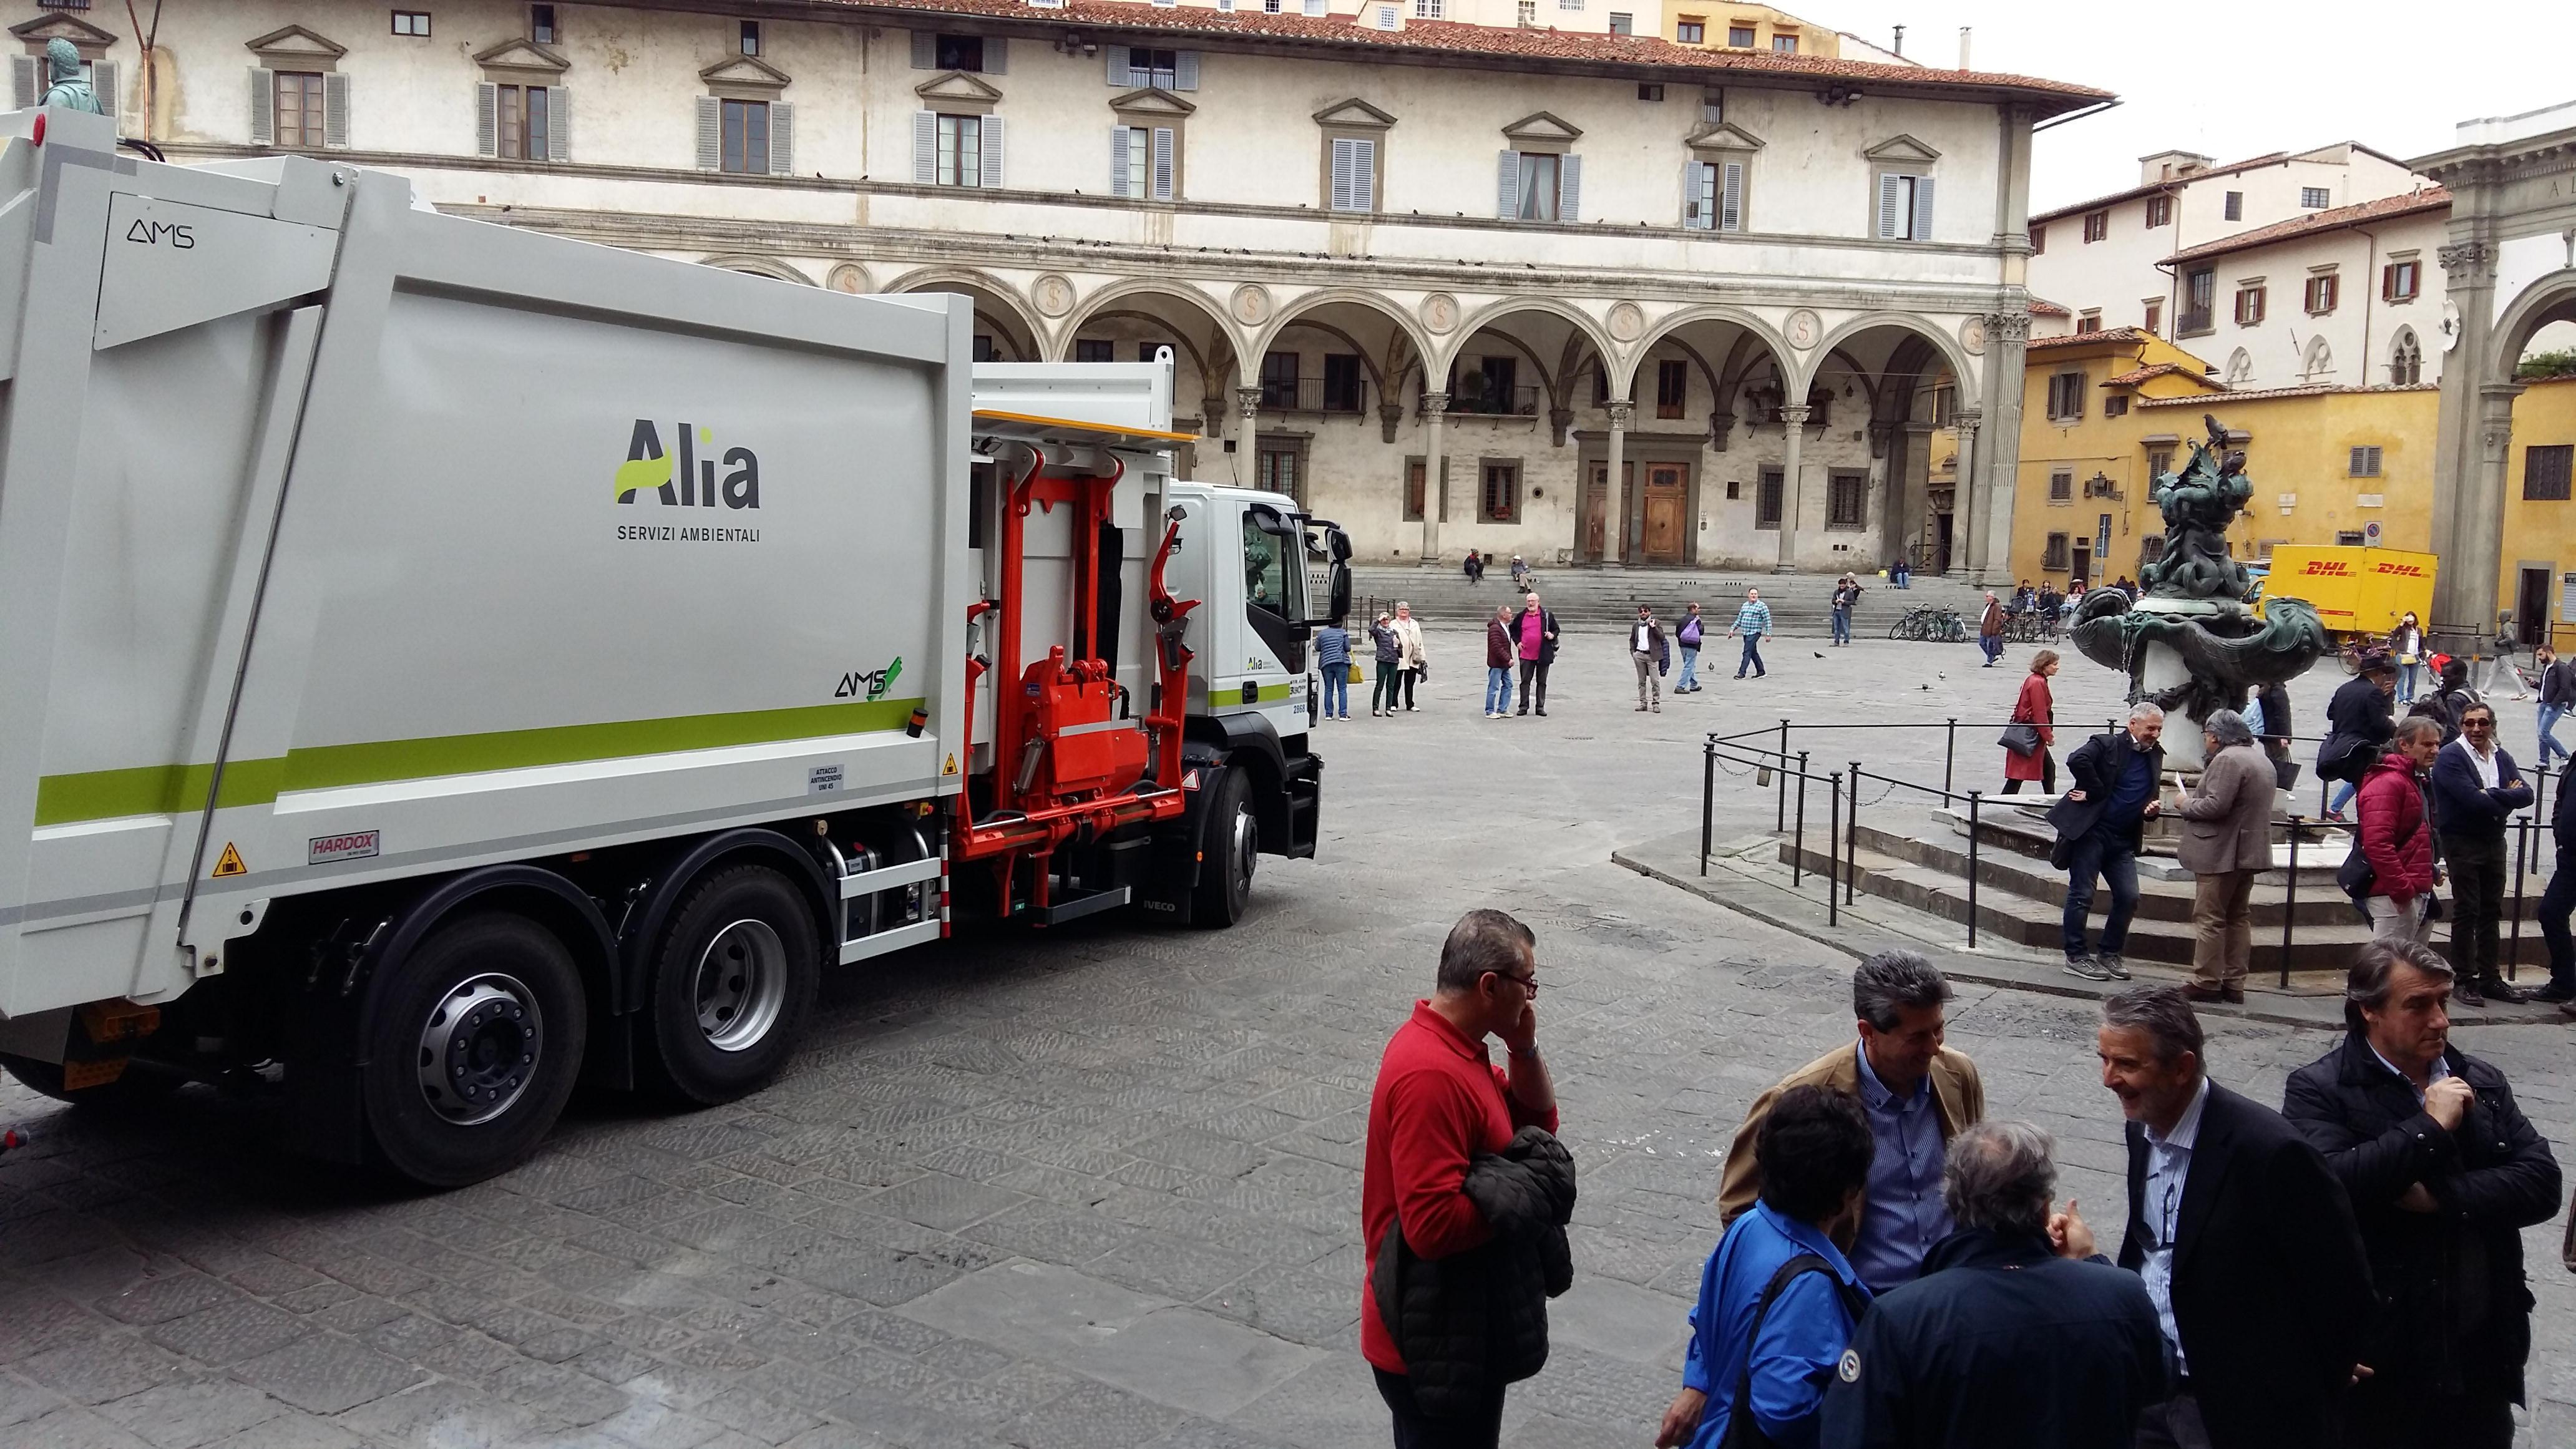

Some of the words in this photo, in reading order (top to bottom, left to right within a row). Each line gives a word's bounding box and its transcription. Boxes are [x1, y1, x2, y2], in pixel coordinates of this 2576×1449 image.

[127, 219, 194, 249] AMS
[615, 419, 760, 509] Alia
[617, 525, 675, 541] SERVIZI
[680, 527, 759, 542] AMBIENTALI
[2306, 561, 2347, 576] DHL
[2377, 563, 2421, 577] DHL
[1247, 656, 1262, 670] Alia
[834, 670, 887, 697] AMS
[1293, 704, 1305, 714] 2868
[816, 767, 837, 775] ATTACCO
[811, 774, 842, 784] ANTINCENDIO
[313, 834, 374, 854] HARDOX
[1143, 900, 1175, 912] IVECO
